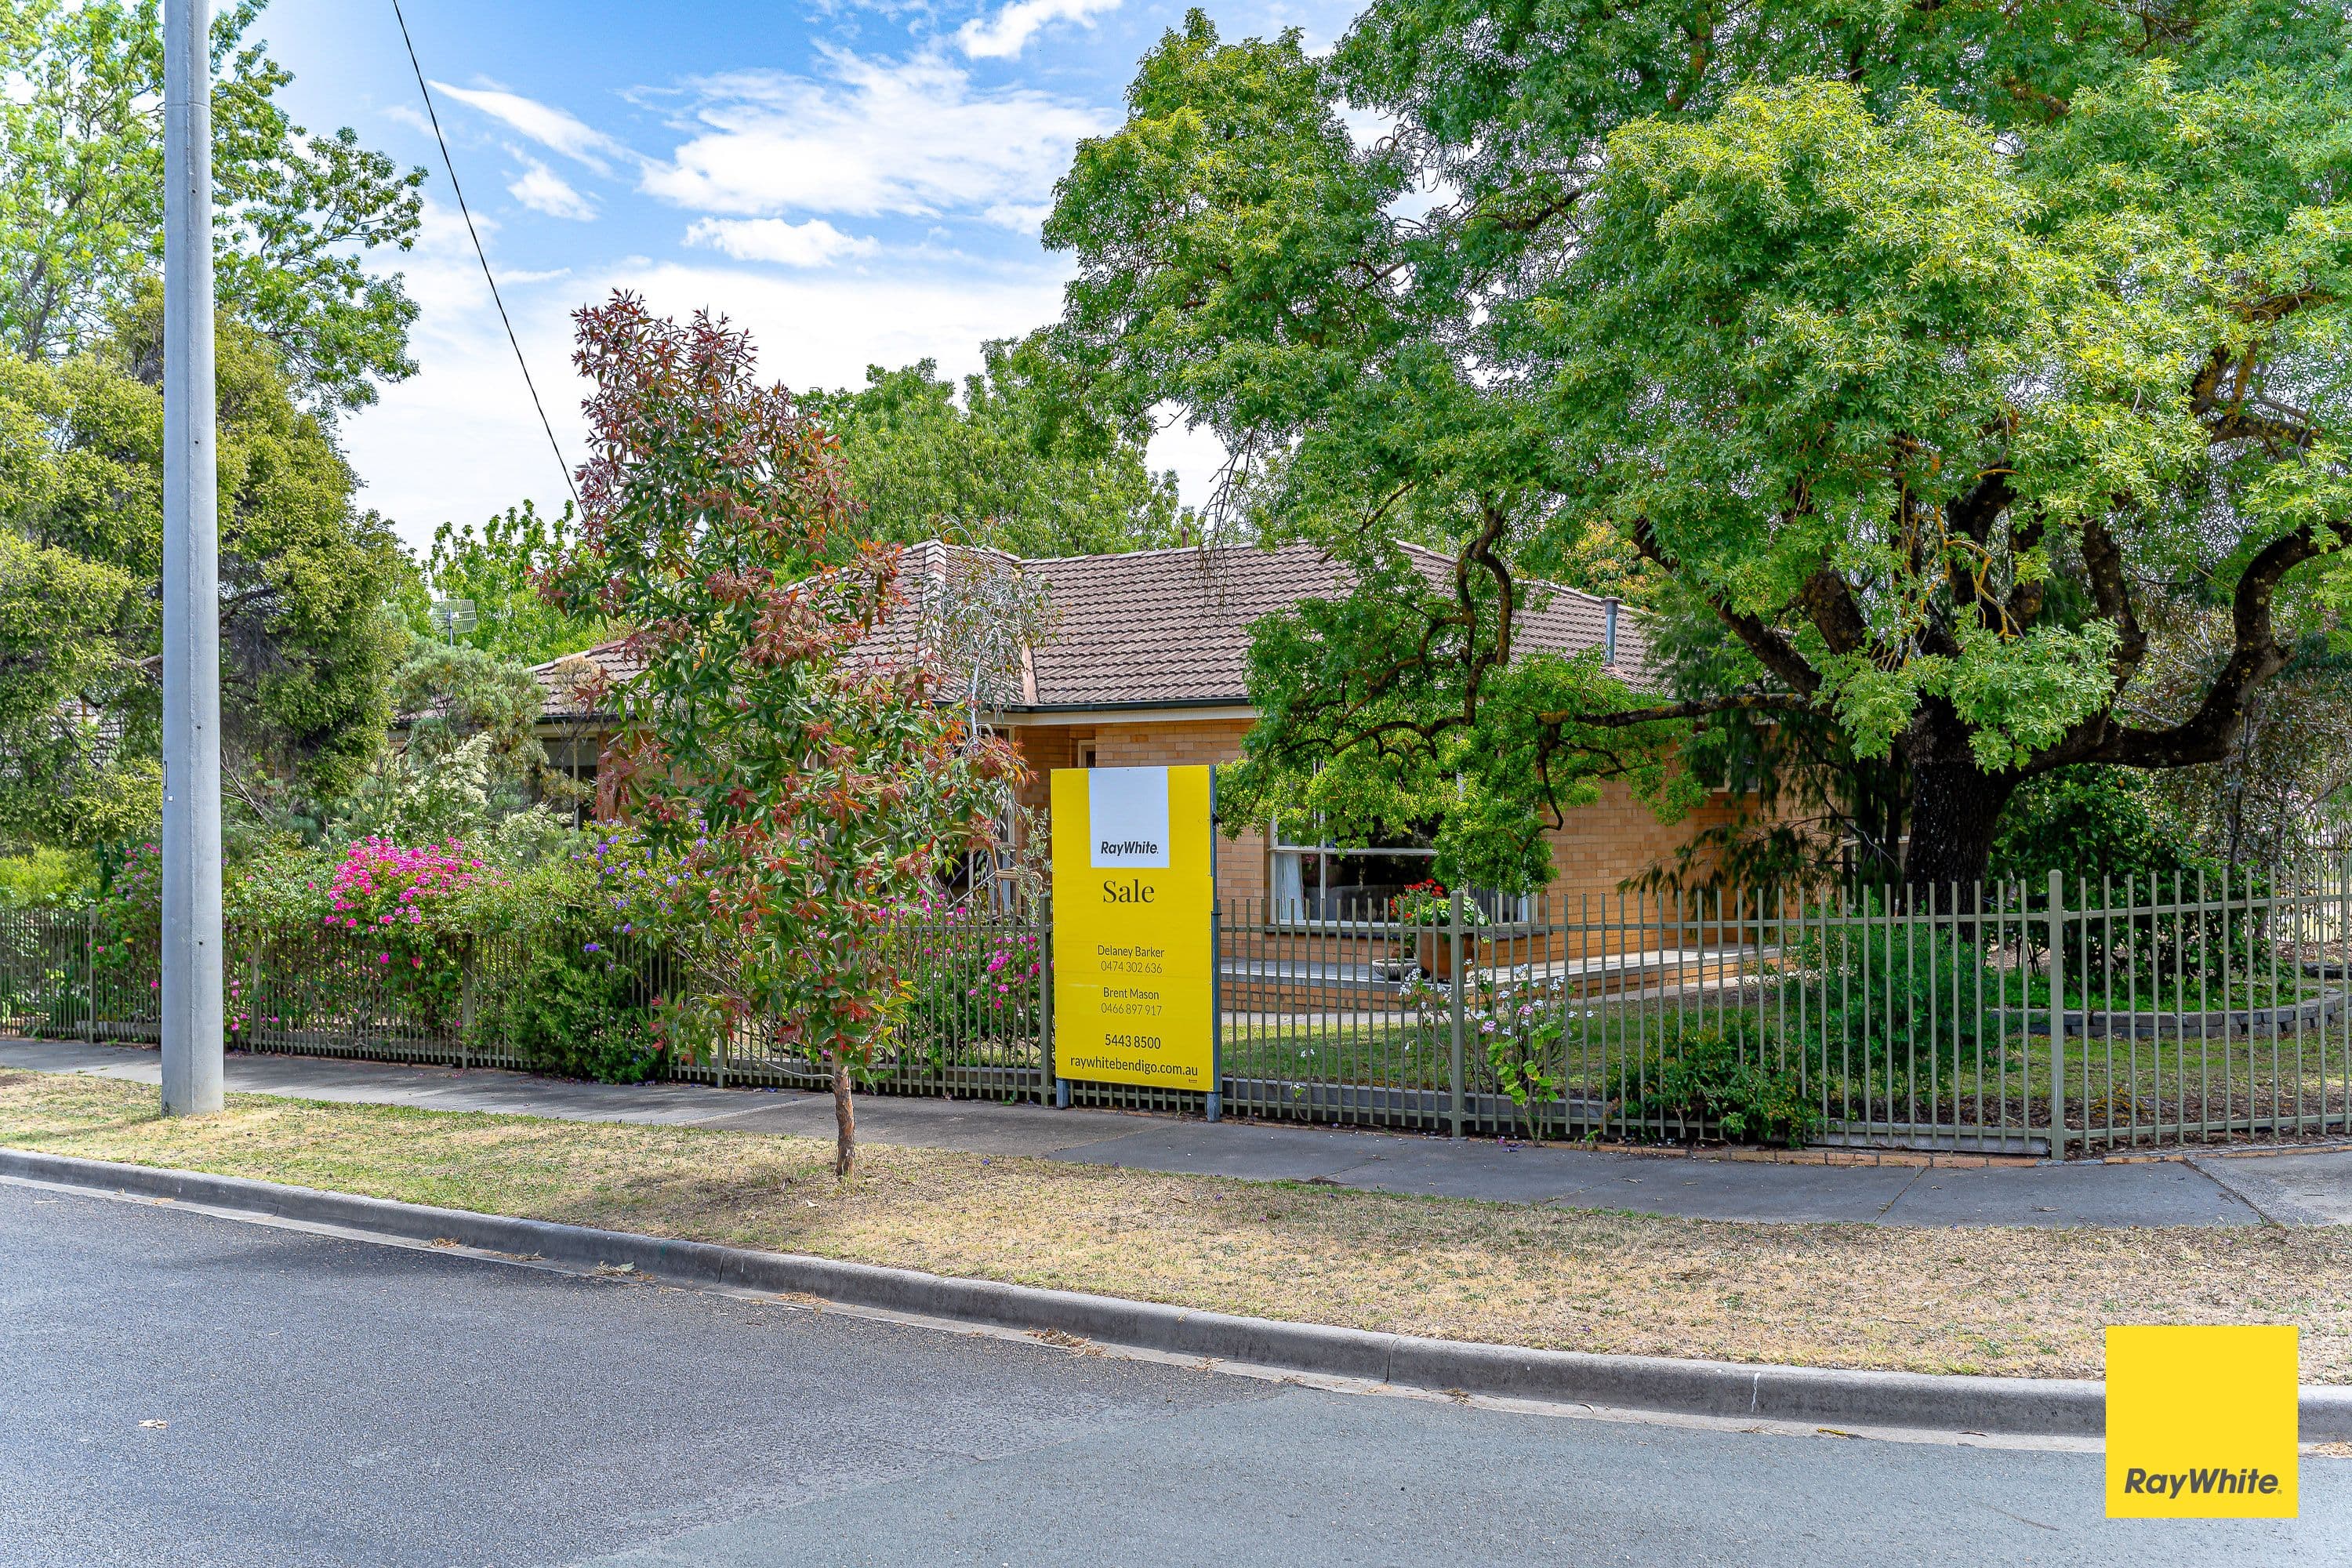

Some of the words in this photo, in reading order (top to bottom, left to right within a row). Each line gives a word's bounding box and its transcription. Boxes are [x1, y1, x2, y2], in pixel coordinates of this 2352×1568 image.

[1103, 878, 1155, 903] Sale
[1098, 945, 1133, 958] Delaney
[1135, 946, 1165, 957] Barker
[1101, 960, 1123, 972] 0474
[1126, 961, 1143, 973] 302
[1145, 962, 1163, 974] 636
[1103, 986, 1127, 999] Brent
[1130, 988, 1160, 1000] Mason
[1101, 1002, 1124, 1014] 0466
[1126, 1003, 1143, 1014] 897
[1145, 1004, 1162, 1016] 917
[1105, 1033, 1131, 1047] 5443
[1134, 1035, 1161, 1050] 8500
[1070, 1055, 1198, 1076] raywhitebendigo.com.au
